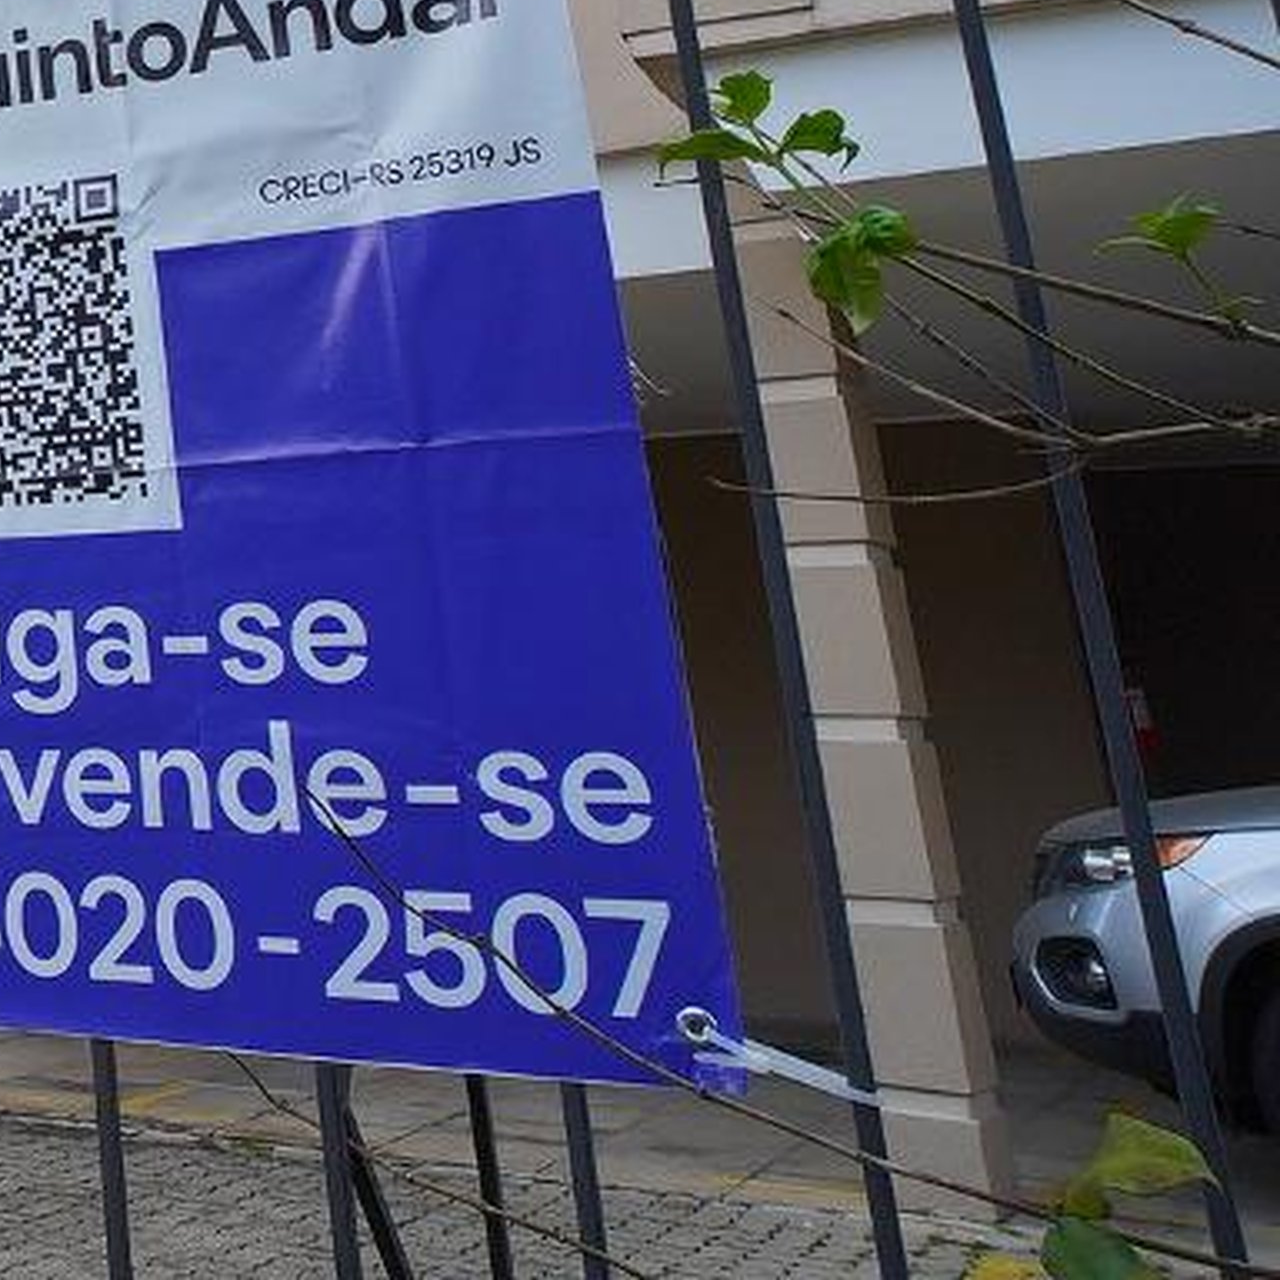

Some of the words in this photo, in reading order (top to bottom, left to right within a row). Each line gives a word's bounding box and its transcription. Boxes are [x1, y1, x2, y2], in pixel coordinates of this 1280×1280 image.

[258, 160, 405, 205] CRECI-RS
[408, 142, 496, 181] 25319
[503, 136, 542, 168] JS
